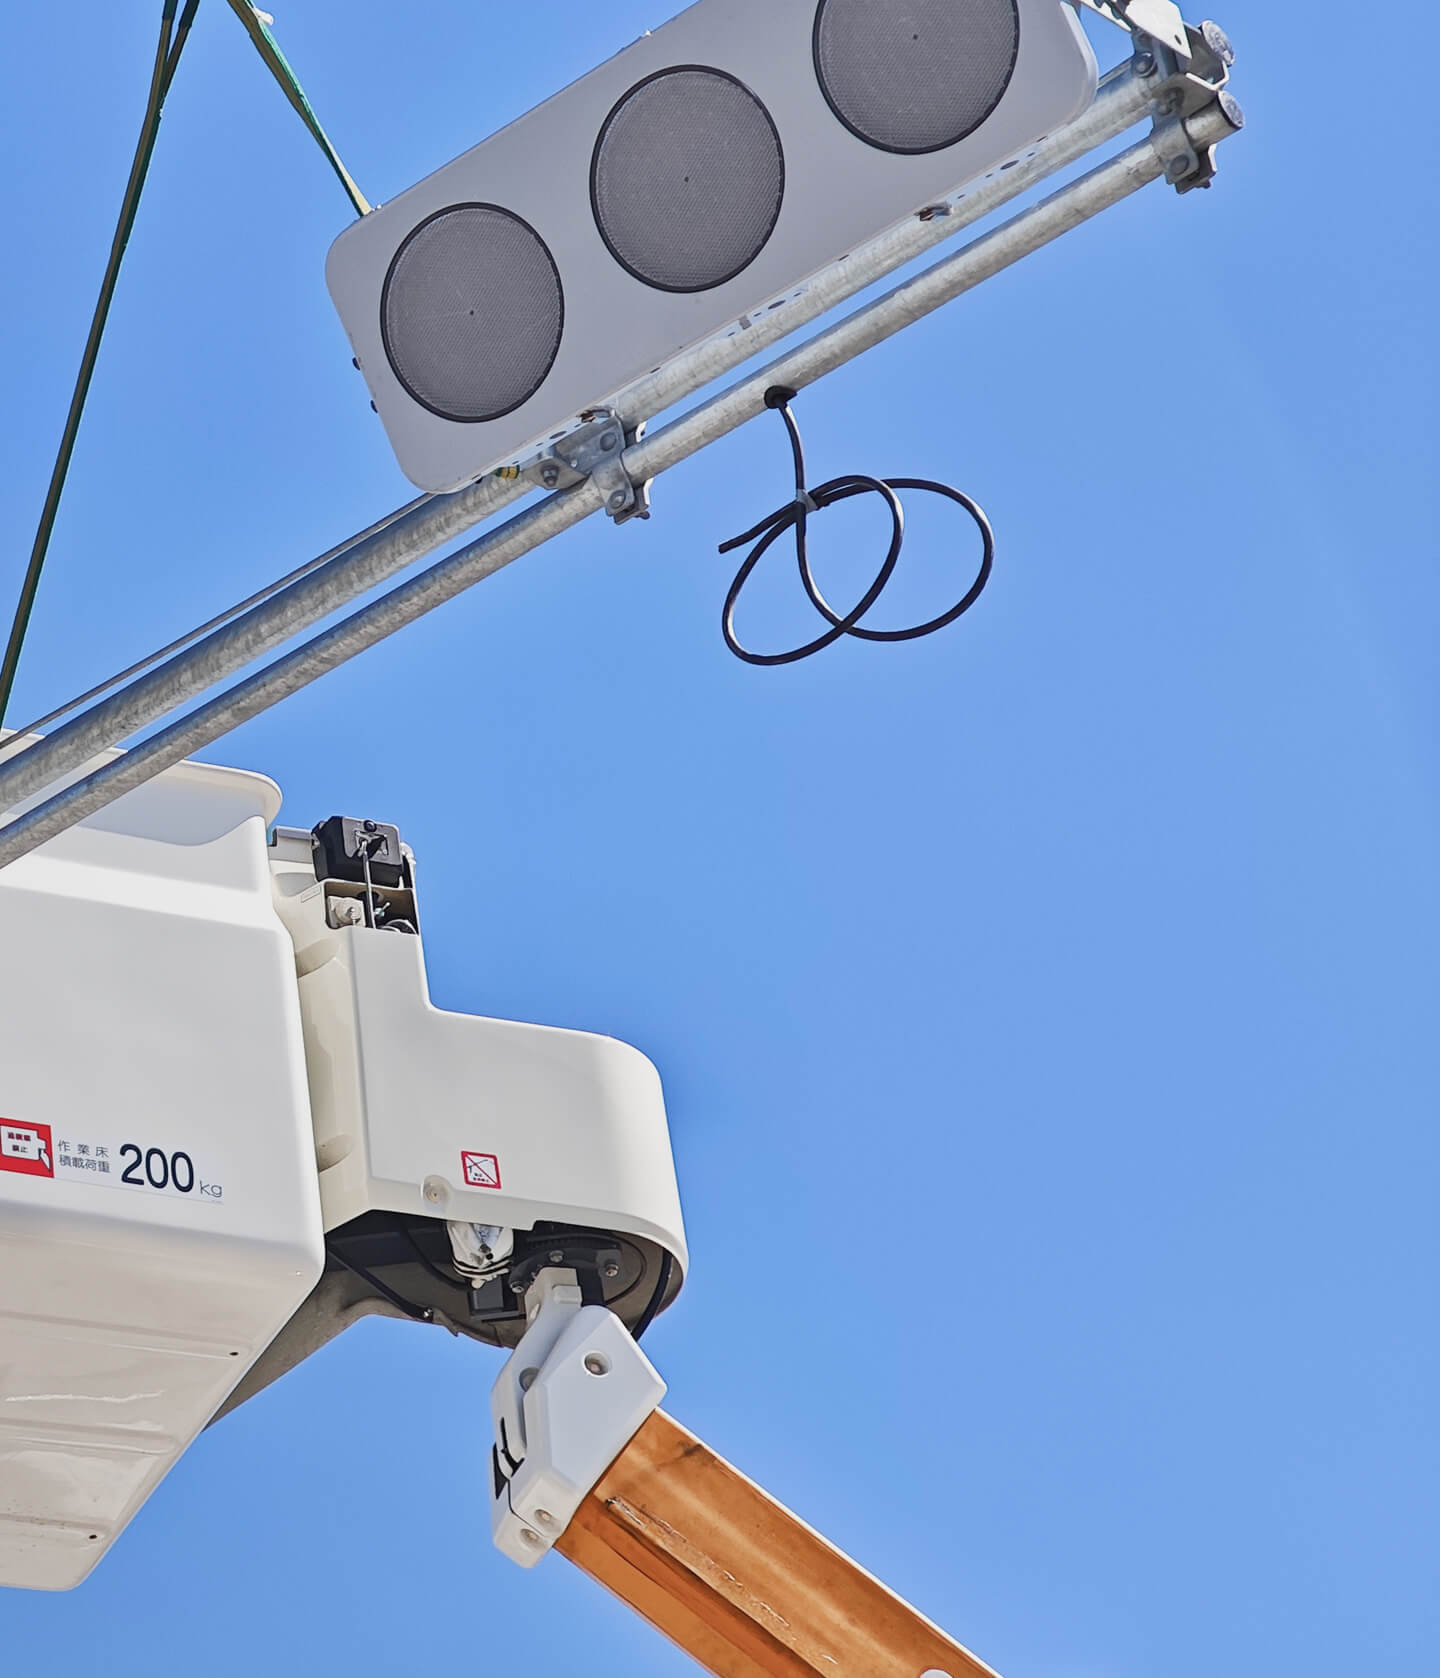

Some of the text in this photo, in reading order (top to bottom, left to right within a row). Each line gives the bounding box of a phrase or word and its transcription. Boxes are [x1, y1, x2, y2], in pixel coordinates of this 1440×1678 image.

[58, 1140, 110, 1158] 作業床
[59, 1154, 110, 1173] 積載荷重
[120, 1143, 223, 1198] 200 kg
